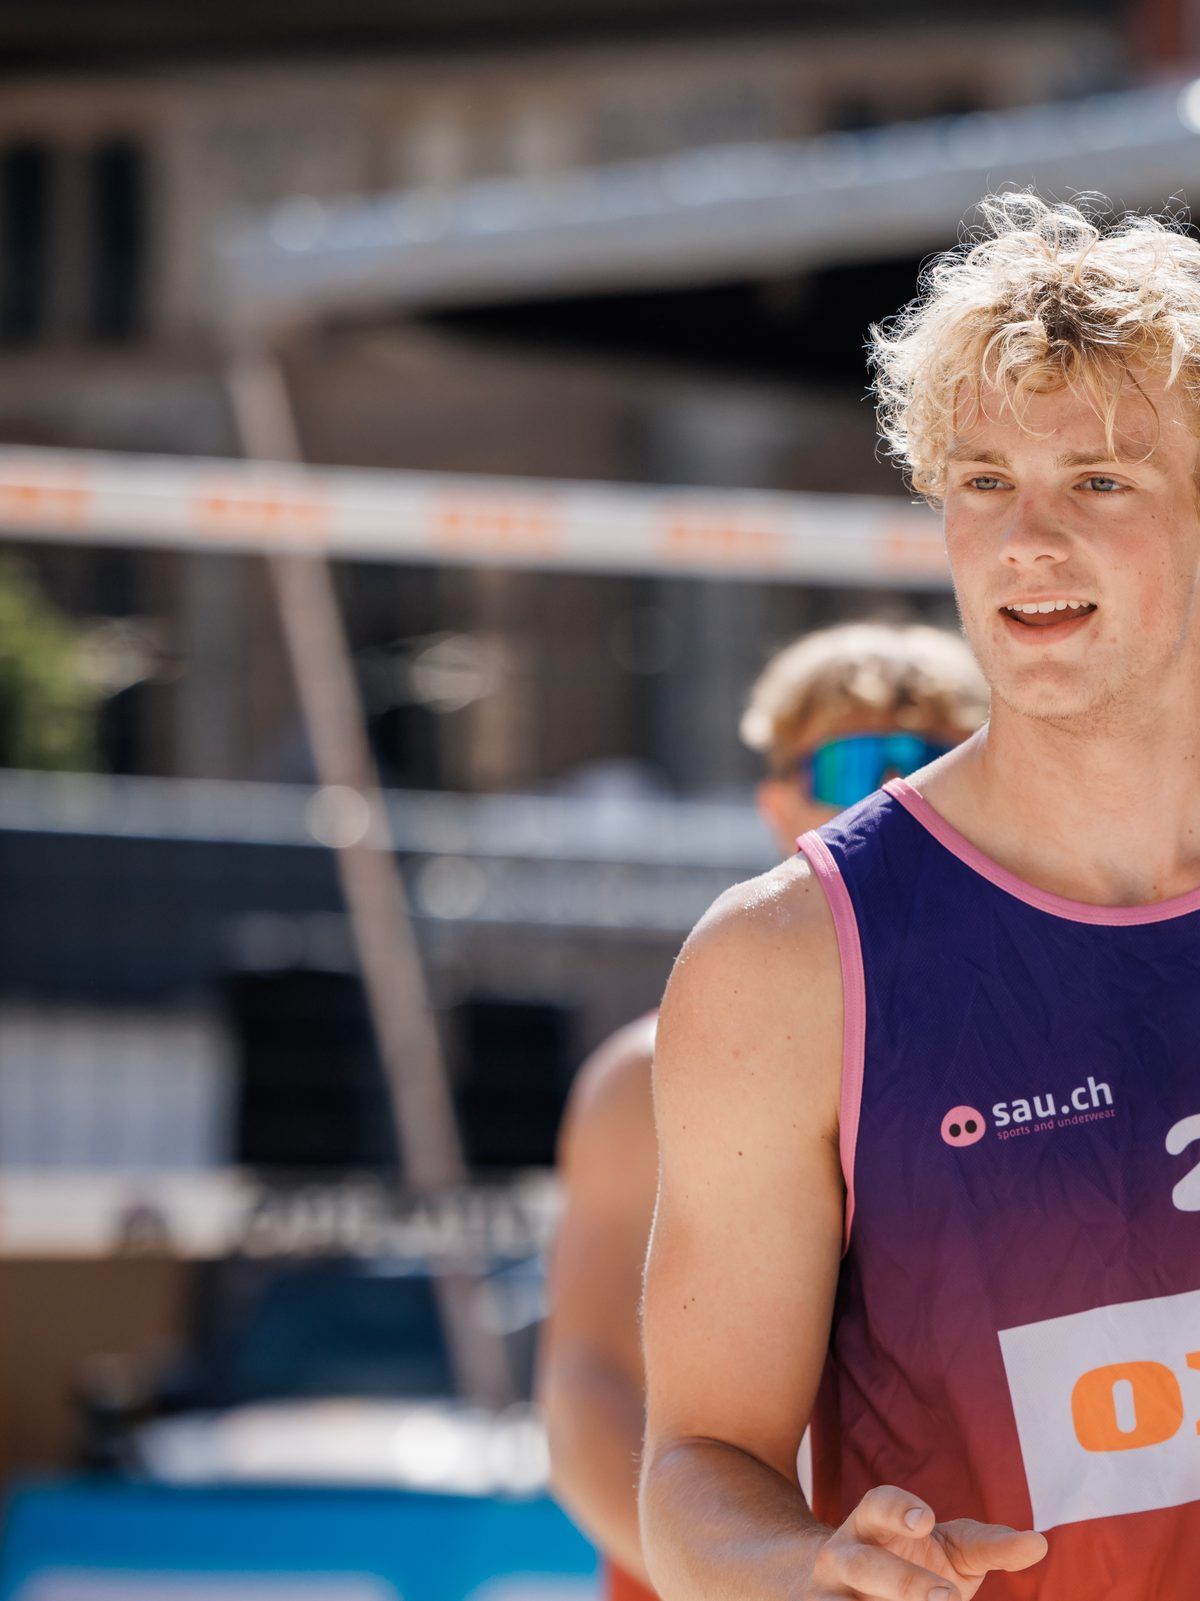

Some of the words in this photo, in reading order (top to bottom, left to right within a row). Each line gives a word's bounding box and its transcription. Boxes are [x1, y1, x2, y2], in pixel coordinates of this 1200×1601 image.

[992, 1076, 1113, 1126] sau.ch
[997, 1125, 1031, 1140] sports
[1033, 1119, 1055, 1132] and
[1057, 1109, 1116, 1127] underwear
